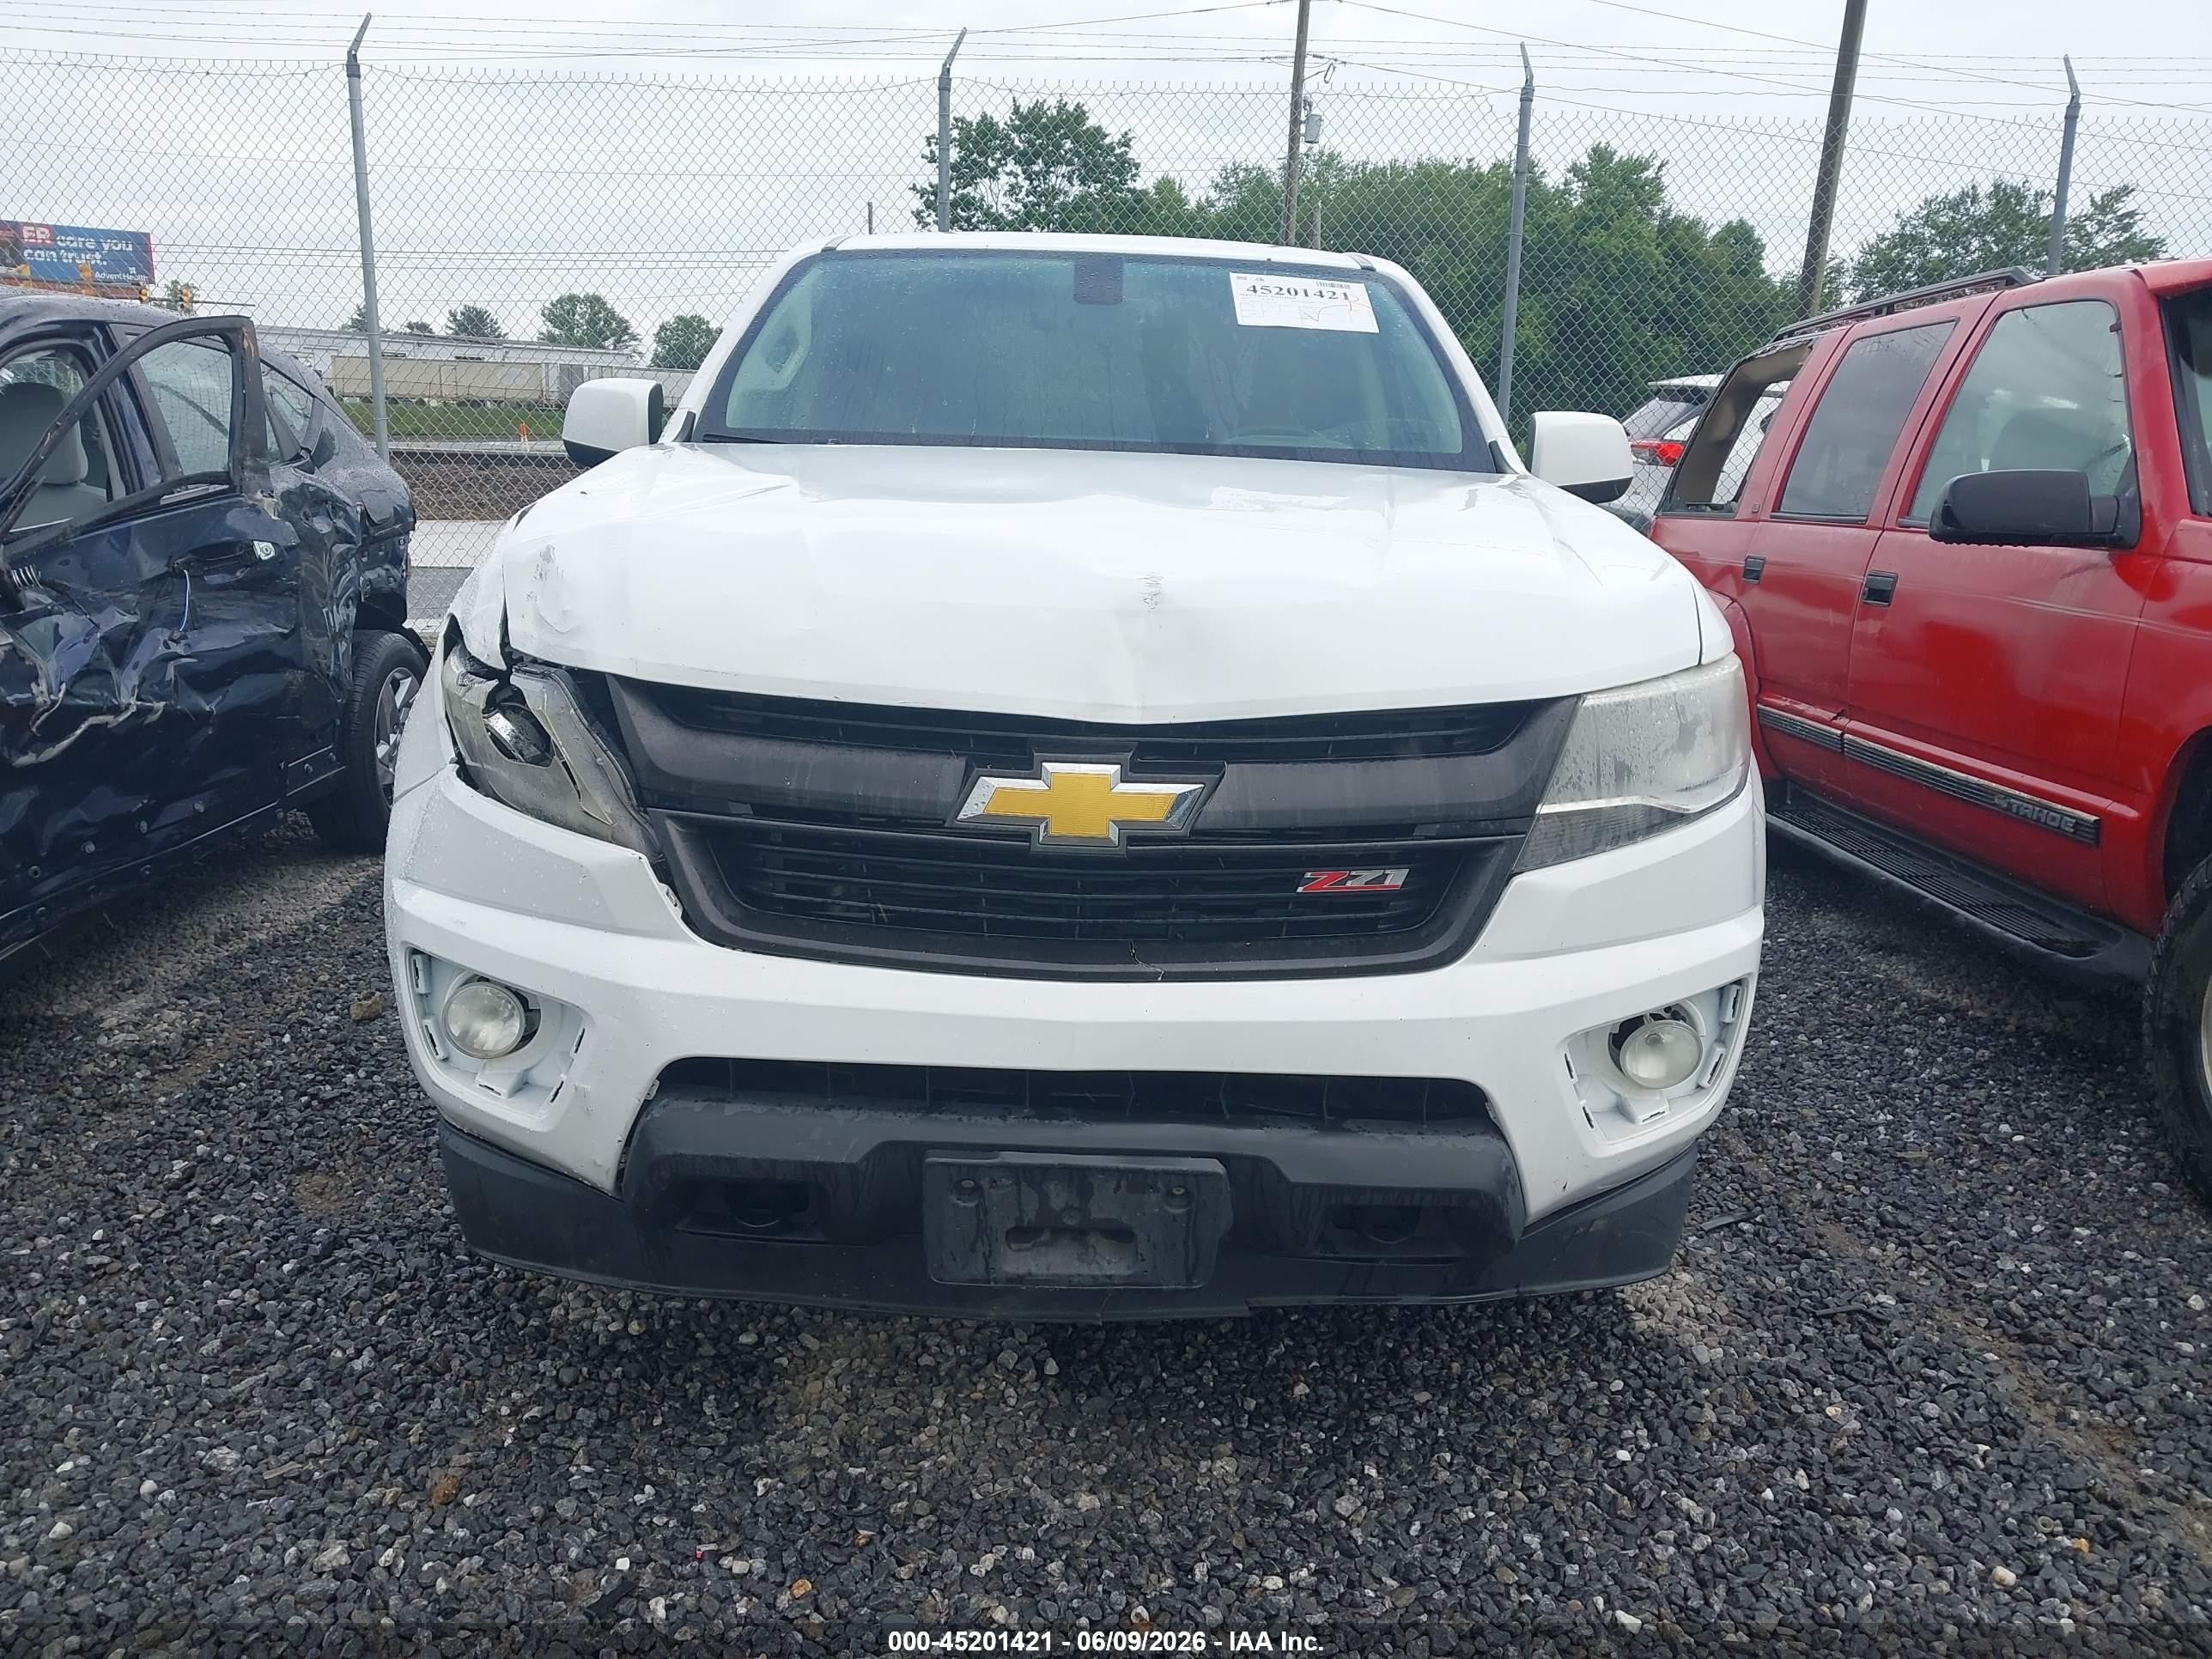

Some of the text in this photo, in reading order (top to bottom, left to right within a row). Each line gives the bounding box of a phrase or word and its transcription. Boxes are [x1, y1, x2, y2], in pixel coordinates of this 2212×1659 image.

[22, 226, 133, 253] ER care you
[23, 249, 107, 266] can trust.
[1246, 284, 1350, 301] 45201421
[2009, 798, 2076, 833] TAHOE
[1296, 868, 1410, 893] Z71
